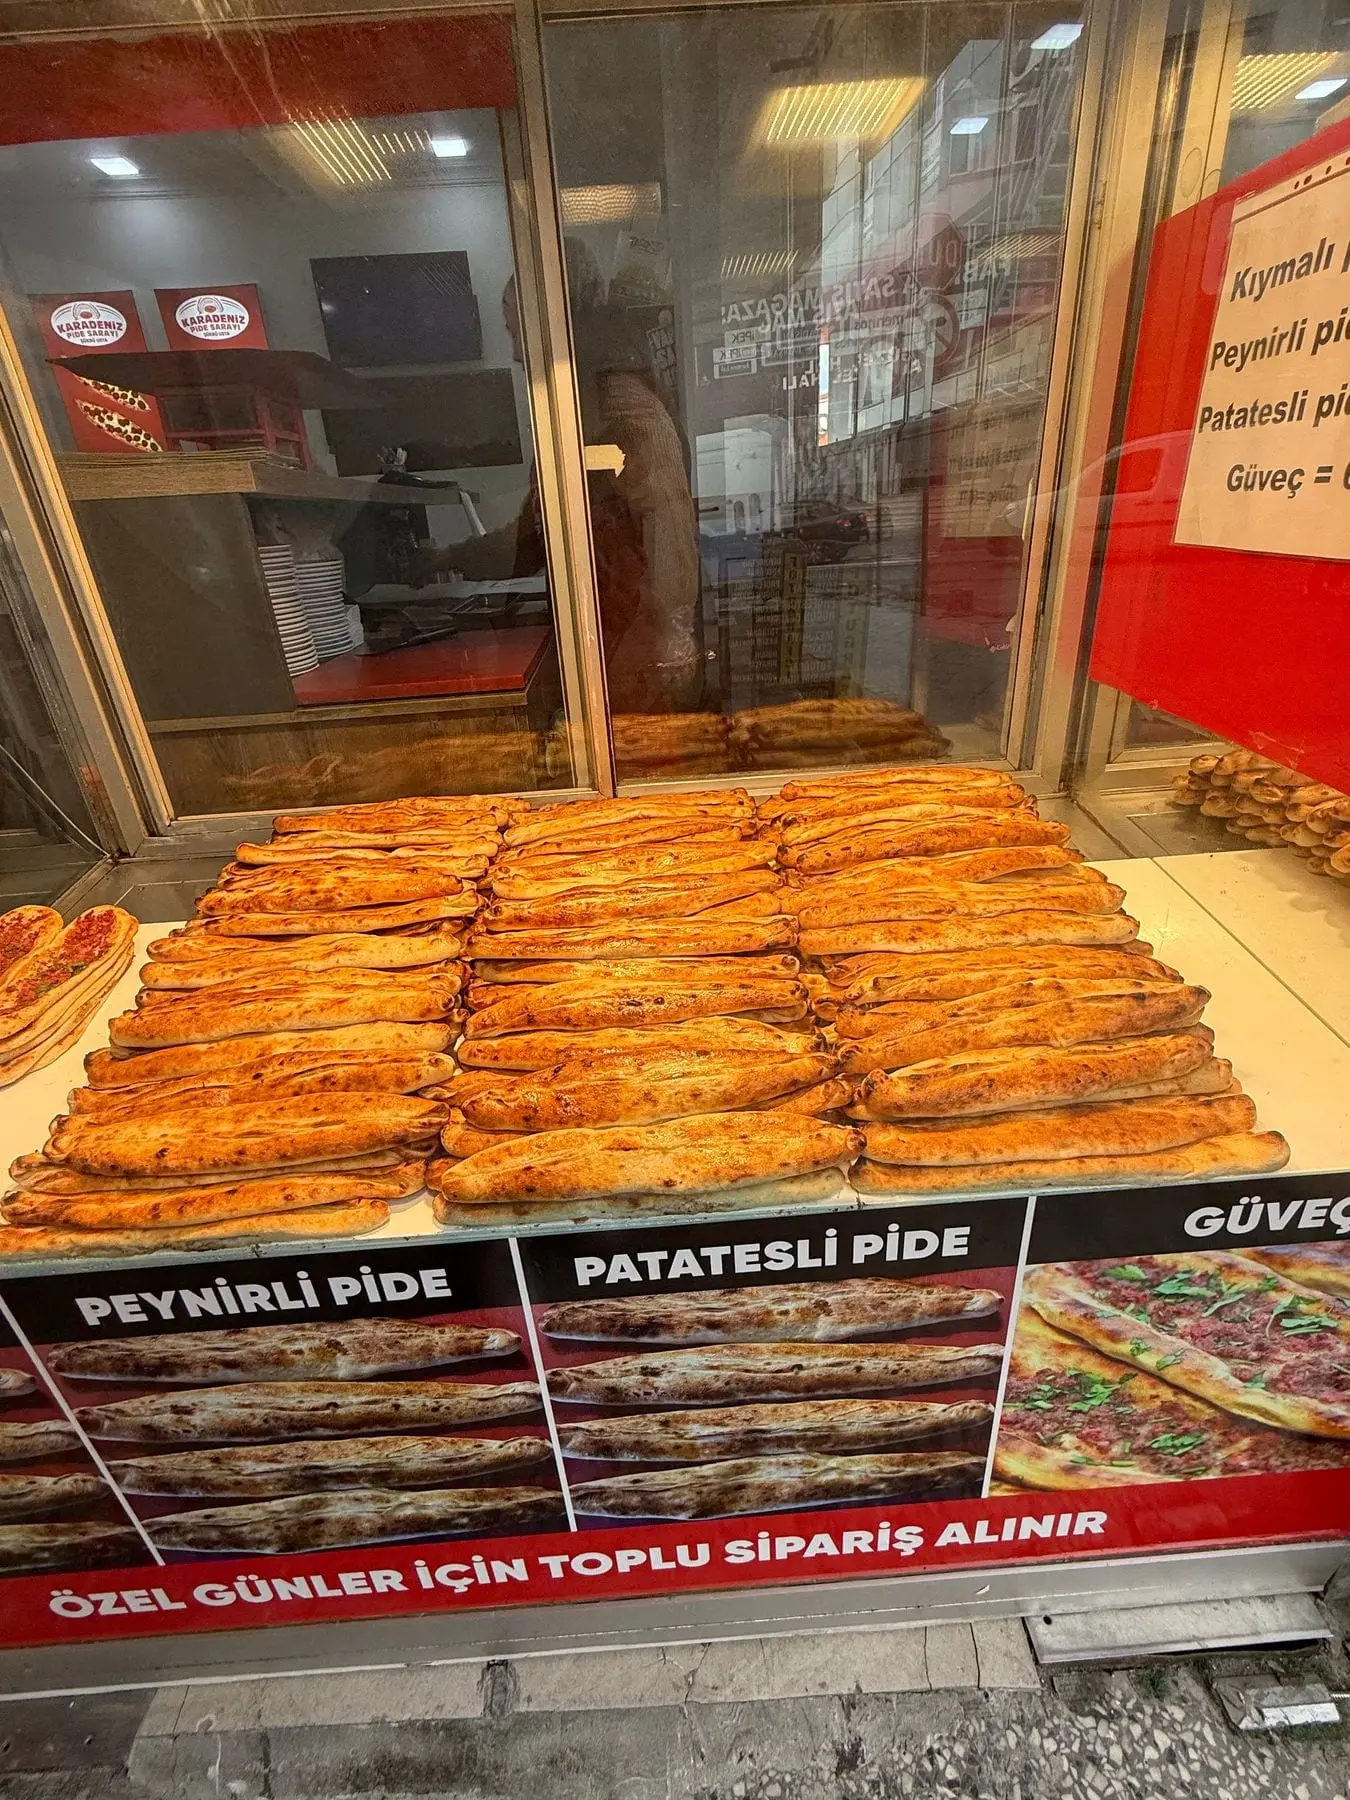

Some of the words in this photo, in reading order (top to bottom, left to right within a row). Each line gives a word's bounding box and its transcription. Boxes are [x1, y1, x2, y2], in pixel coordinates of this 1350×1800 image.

[1230, 236, 1335, 303] Kıymalı
[1210, 317, 1307, 372] Peynirli
[1198, 389, 1309, 433] Patatesli
[1226, 463, 1305, 500] Güveç
[1183, 1196, 1350, 1238] GÜVEÇ
[574, 1228, 838, 1285] PATATESLİ
[853, 1224, 971, 1264] PİDE
[75, 1270, 321, 1326] PEYNİRLİ
[328, 1265, 453, 1306] PİDE
[49, 1588, 188, 1618] ÖZEL
[193, 1569, 409, 1607] GÜNLER
[415, 1554, 529, 1594] İÇİN
[537, 1542, 711, 1579] TOPLU
[724, 1521, 924, 1564] SİPARİŞ
[934, 1510, 1108, 1547] ALINIR
